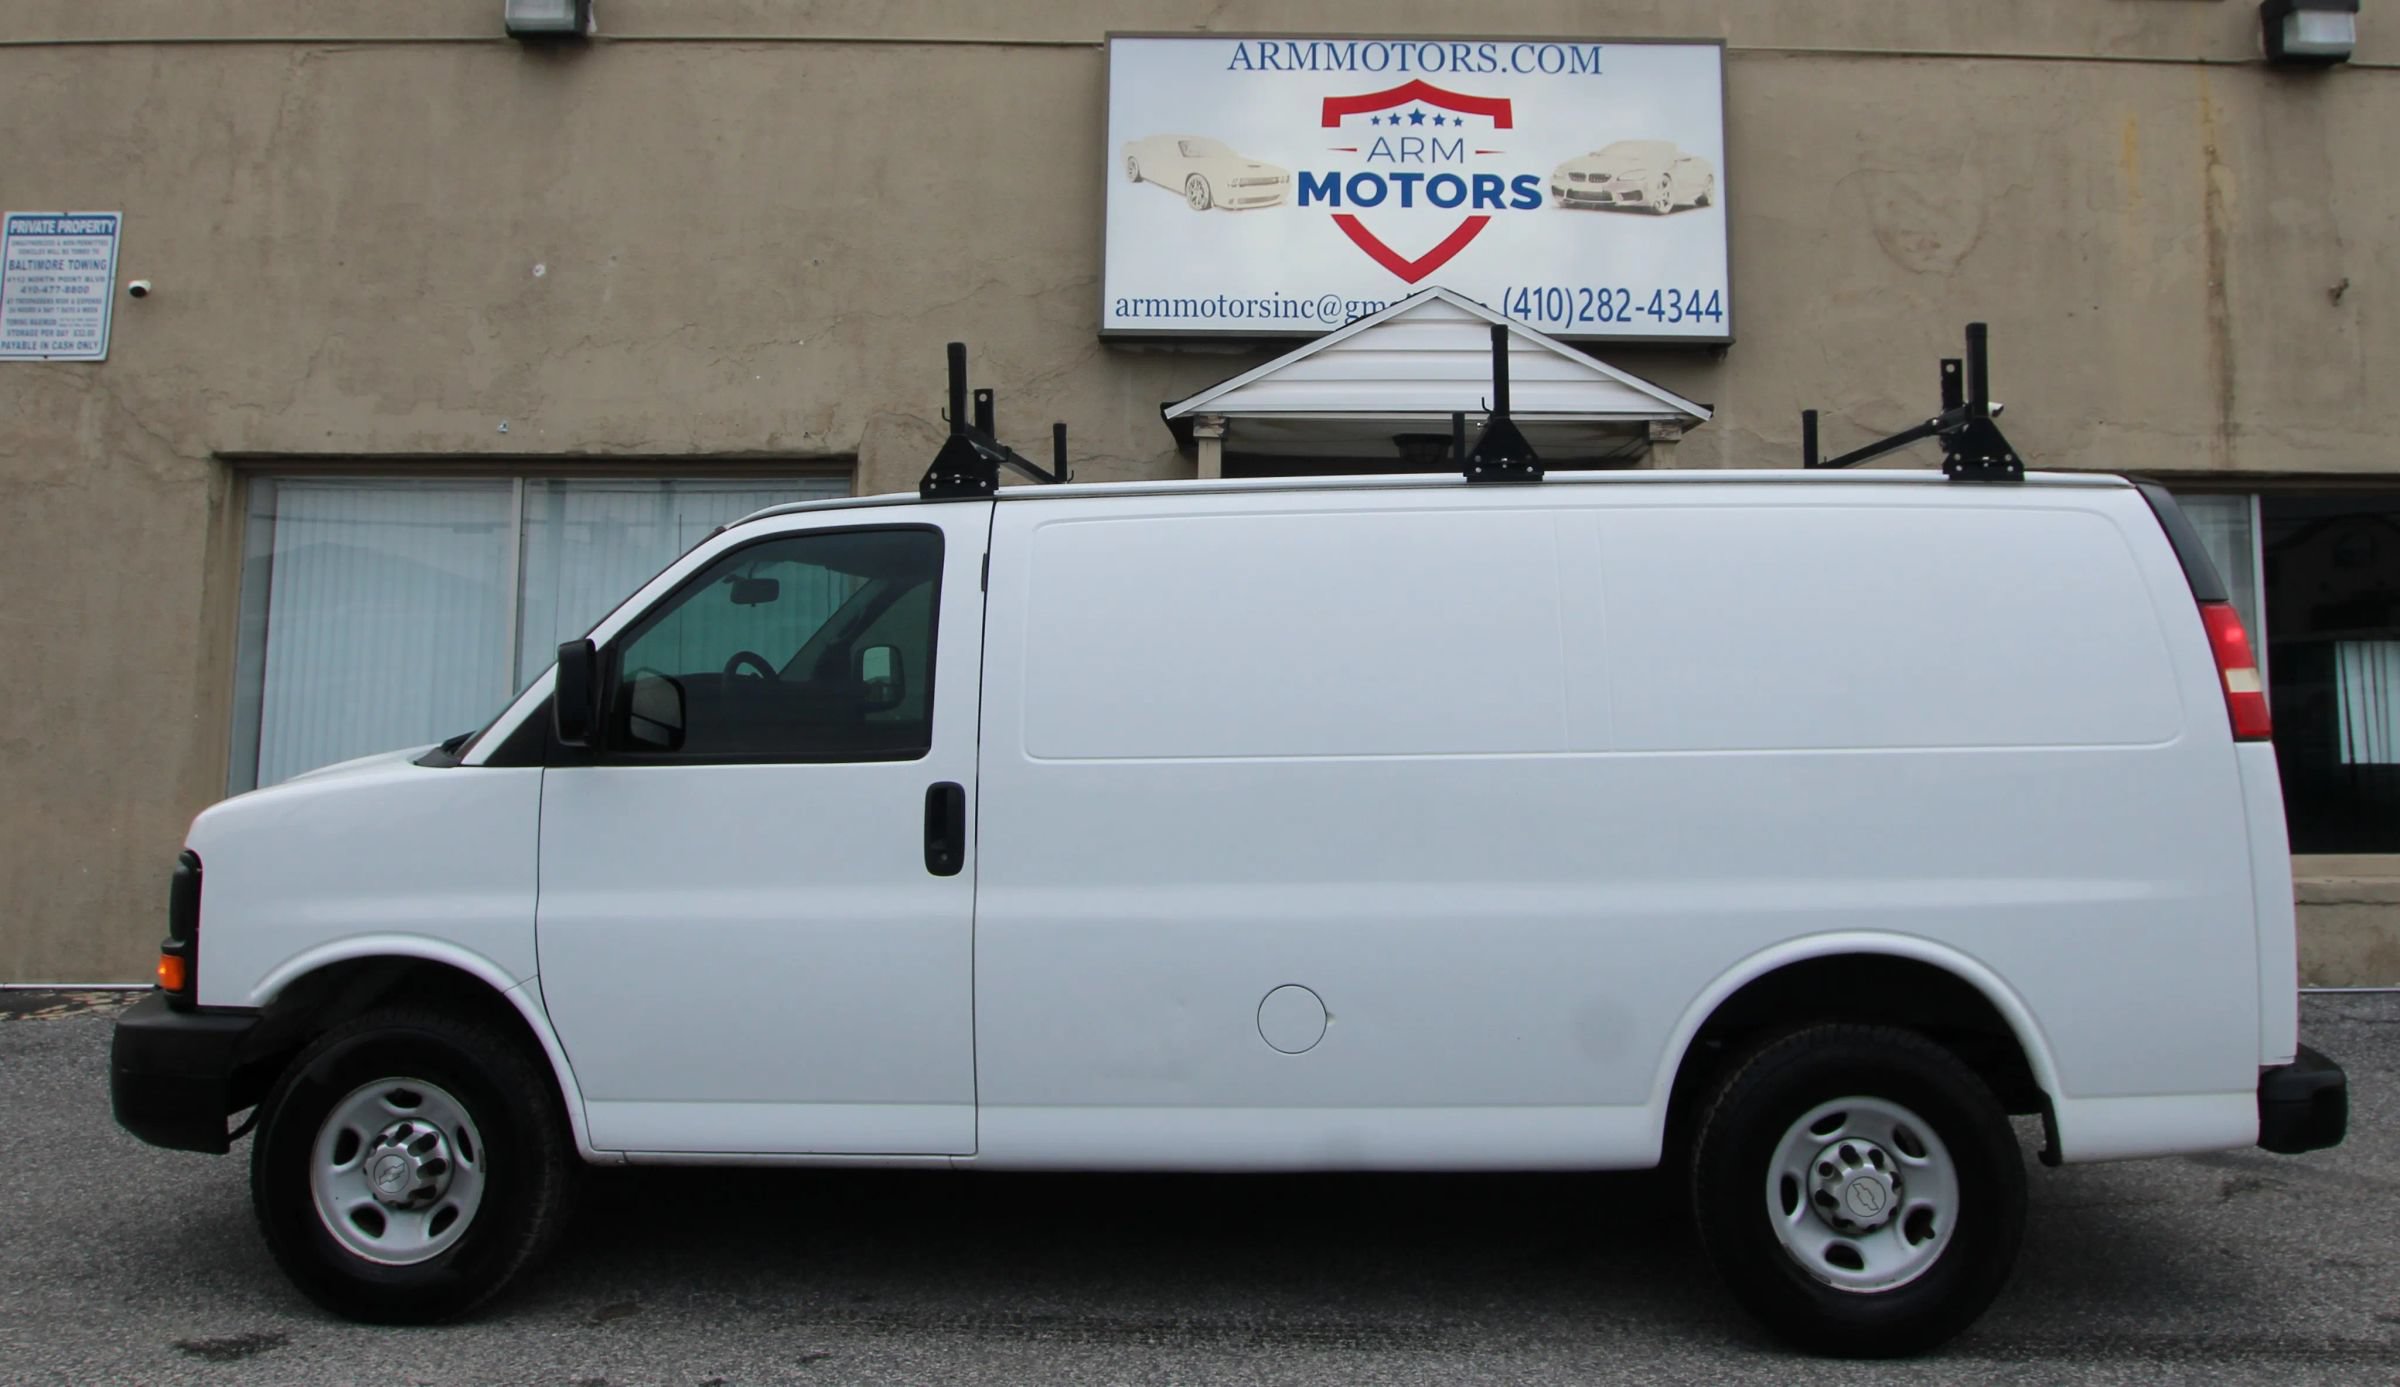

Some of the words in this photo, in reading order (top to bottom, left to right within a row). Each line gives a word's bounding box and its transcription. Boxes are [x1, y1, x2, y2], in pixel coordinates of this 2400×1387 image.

[1227, 41, 1603, 75] ARMMOTORS.COM
[1367, 136, 1464, 163] ARM
[1298, 171, 1543, 210] MOTORS
[10, 220, 56, 234] PRIVATE
[57, 220, 115, 234] PROPERTY
[8, 260, 65, 271] BALTIMORE
[68, 260, 107, 271] TOWING
[1503, 286, 1723, 328] (410)282-4344
[1, 341, 37, 351] PAYABLE
[40, 341, 49, 351] IN
[51, 341, 74, 351] CASH
[76, 341, 99, 351] ONLY
